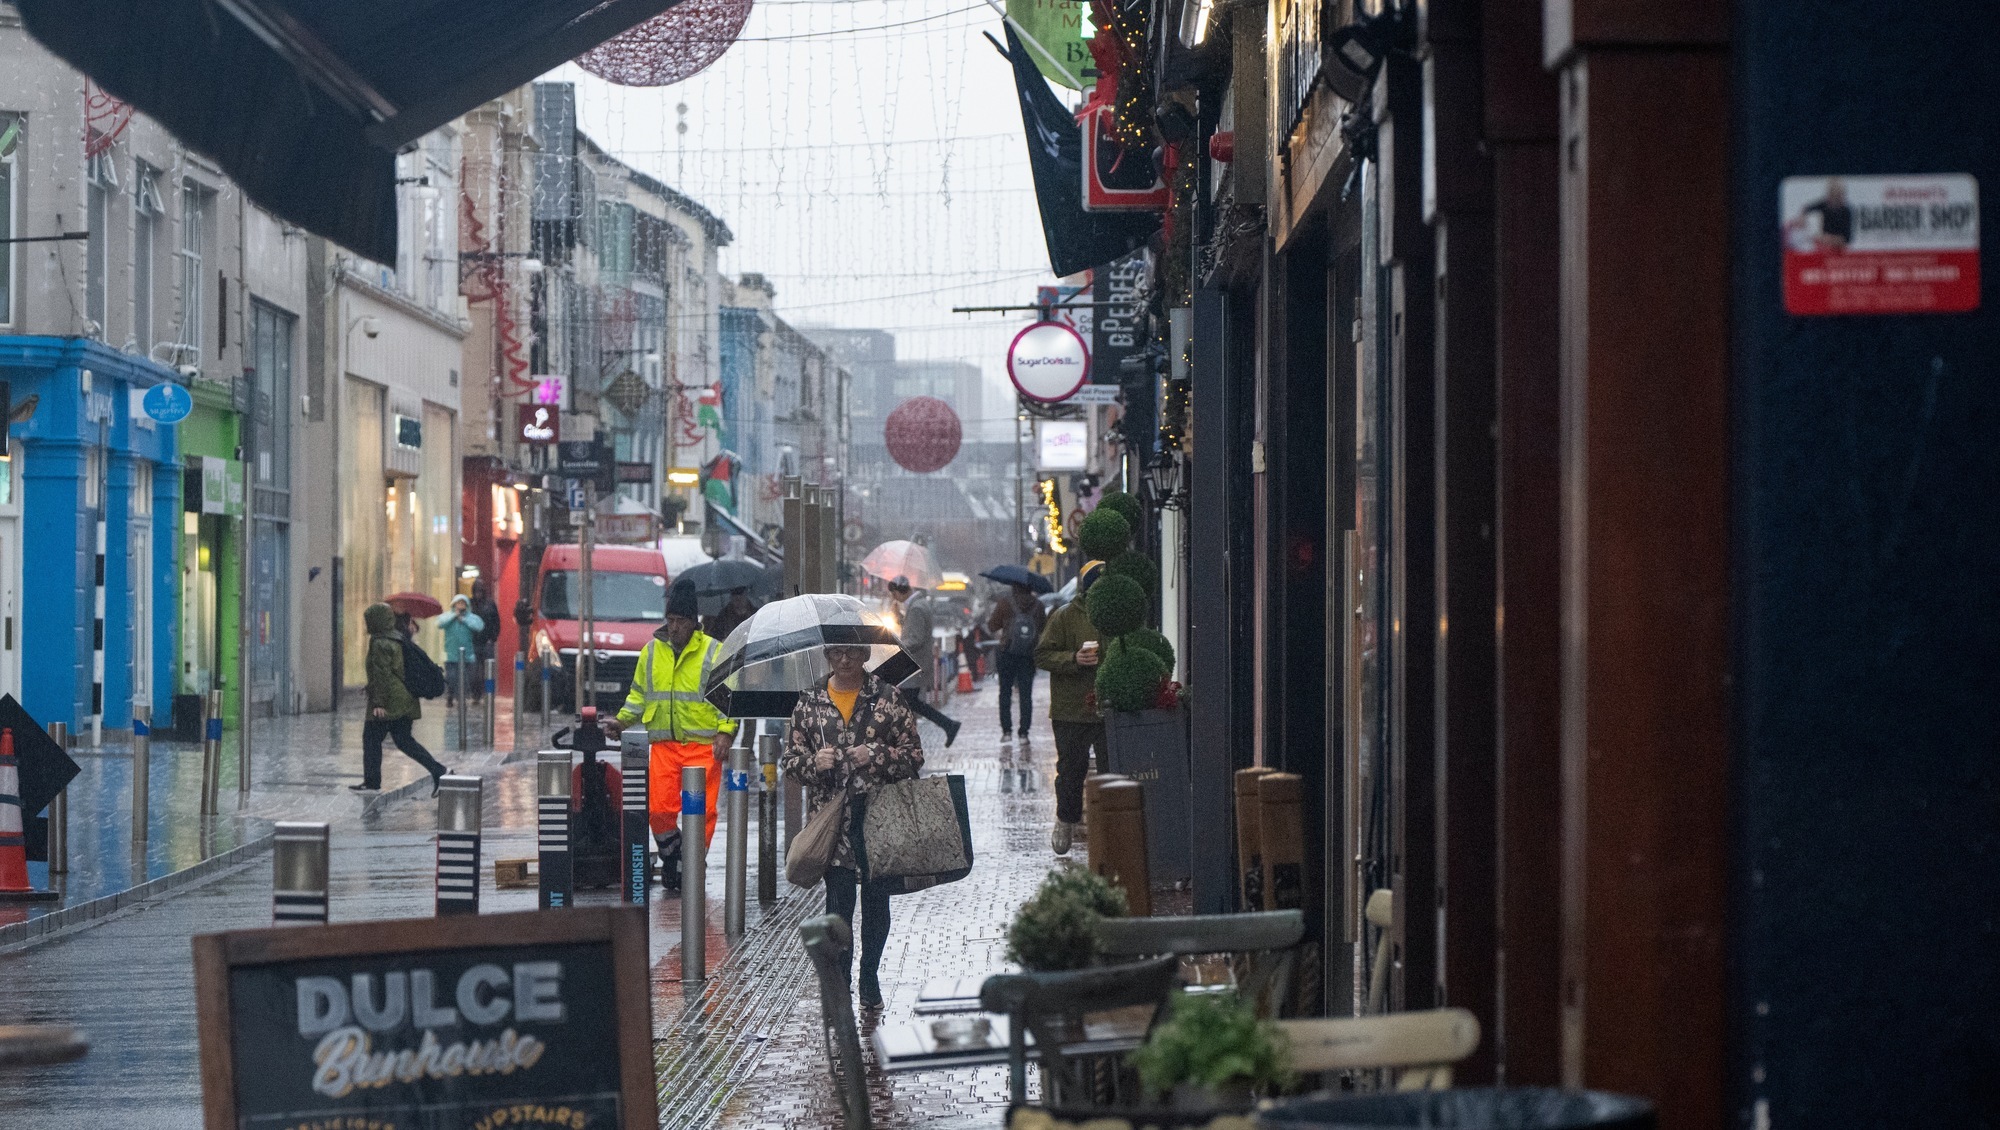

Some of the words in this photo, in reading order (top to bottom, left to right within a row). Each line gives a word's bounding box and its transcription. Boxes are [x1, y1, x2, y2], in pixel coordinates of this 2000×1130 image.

[1930, 203, 1971, 229] SHOP
[296, 961, 564, 1037] DULCE
[312, 1026, 545, 1098] Bunhouse
